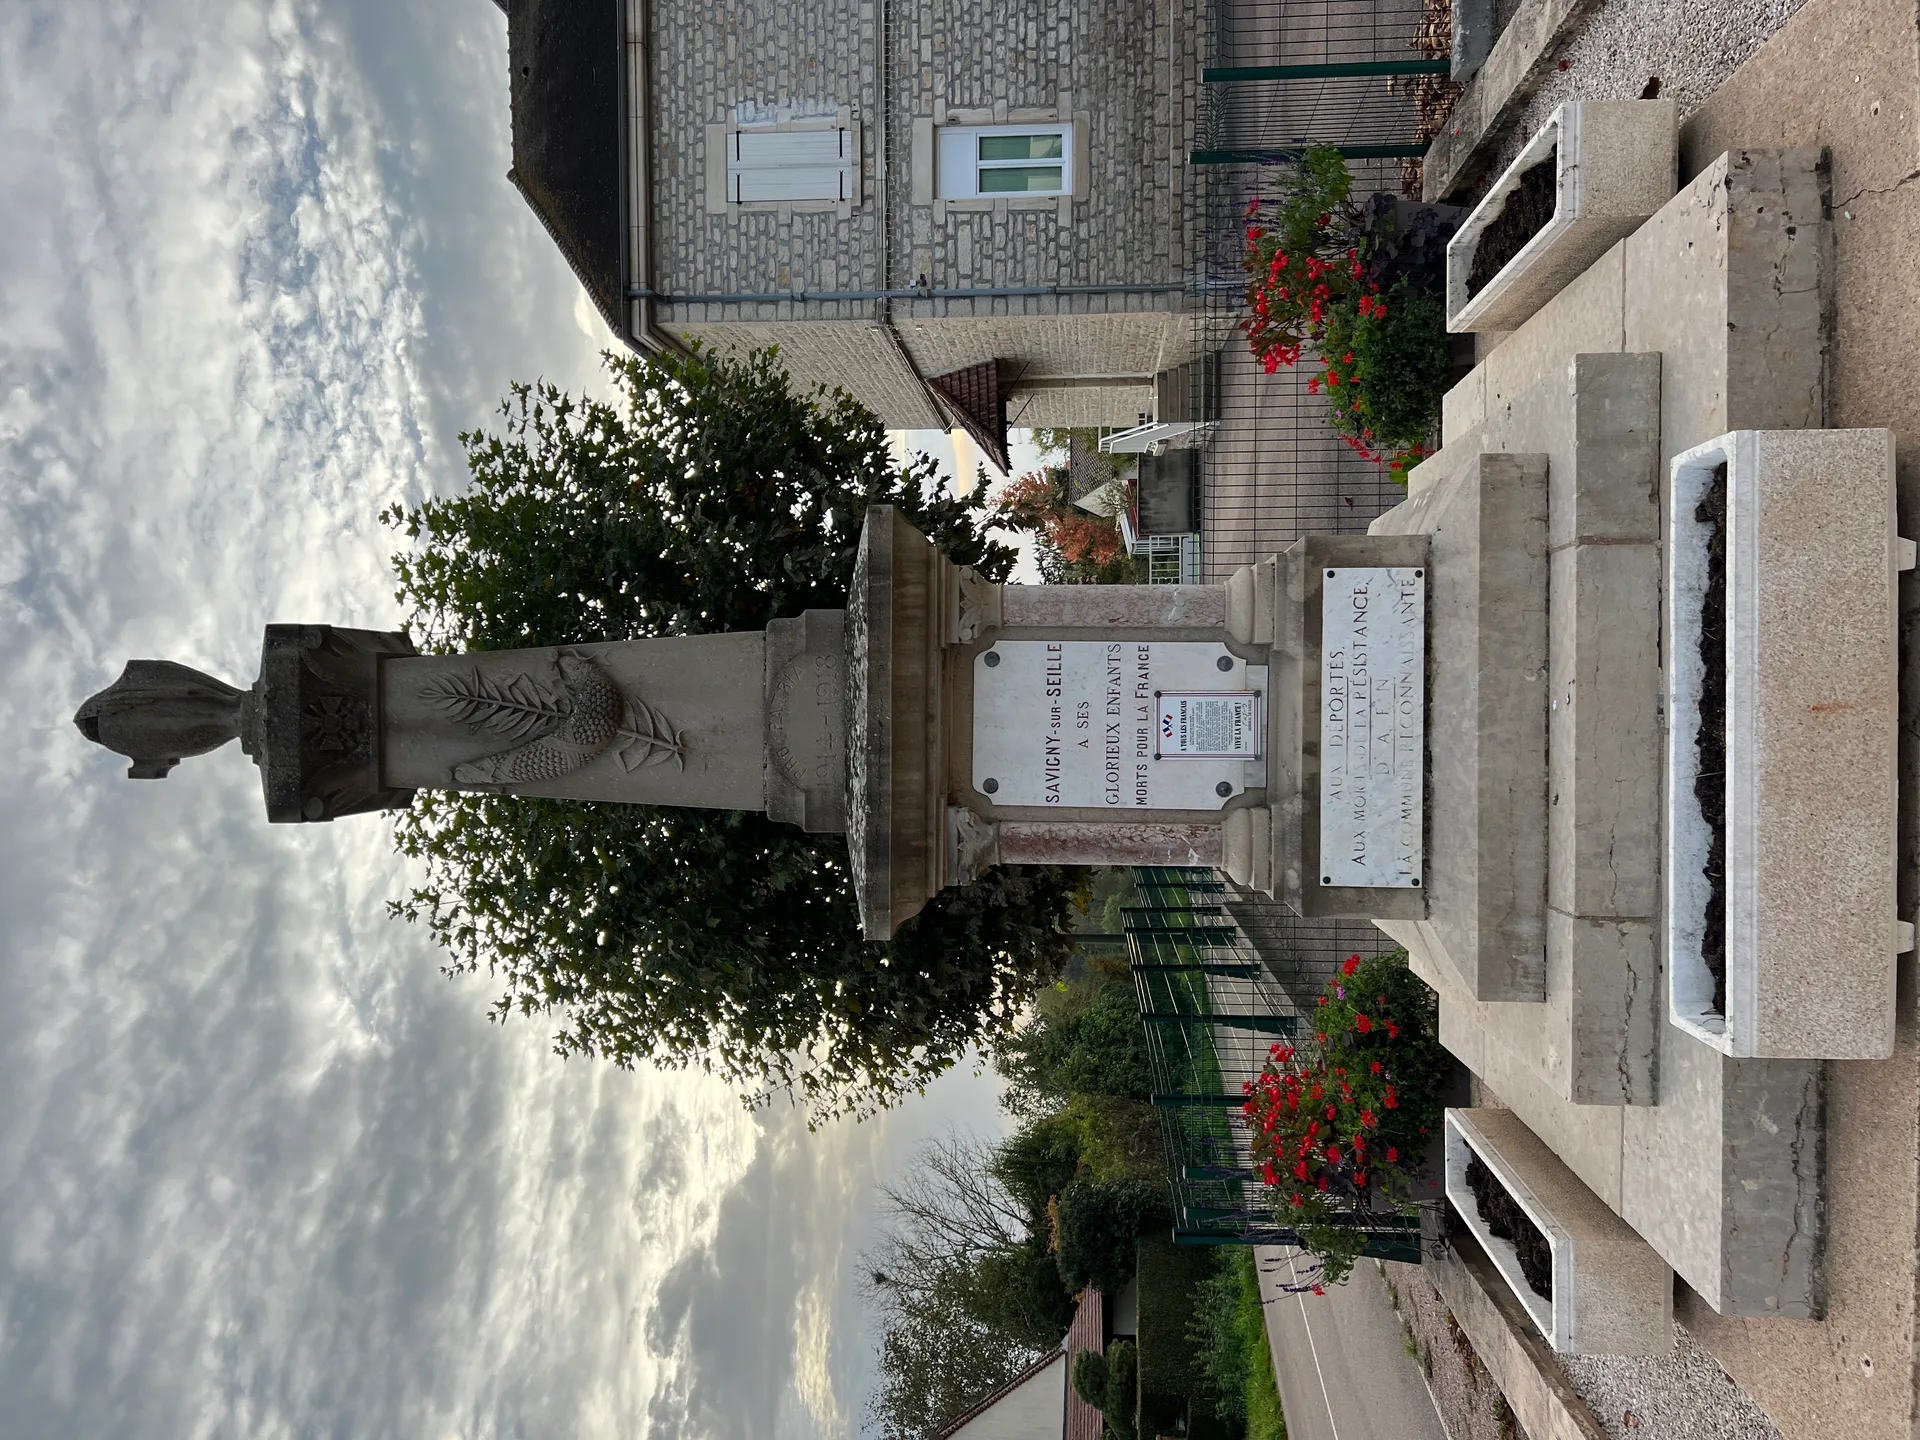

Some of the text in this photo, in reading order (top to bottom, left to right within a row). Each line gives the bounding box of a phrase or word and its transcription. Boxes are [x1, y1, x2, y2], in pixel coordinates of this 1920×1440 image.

[1077, 701, 1089, 748] A SES
[1106, 644, 1121, 805] GLORIEUX ENFANTS
[1135, 645, 1149, 805] MORTS POUR LA FRANCE
[1354, 709, 1366, 727] LA
[1354, 735, 1365, 756] DE
[1330, 766, 1342, 799] AUX
[1401, 760, 1413, 846] COMMUNE
[1352, 831, 1365, 866] AUX
